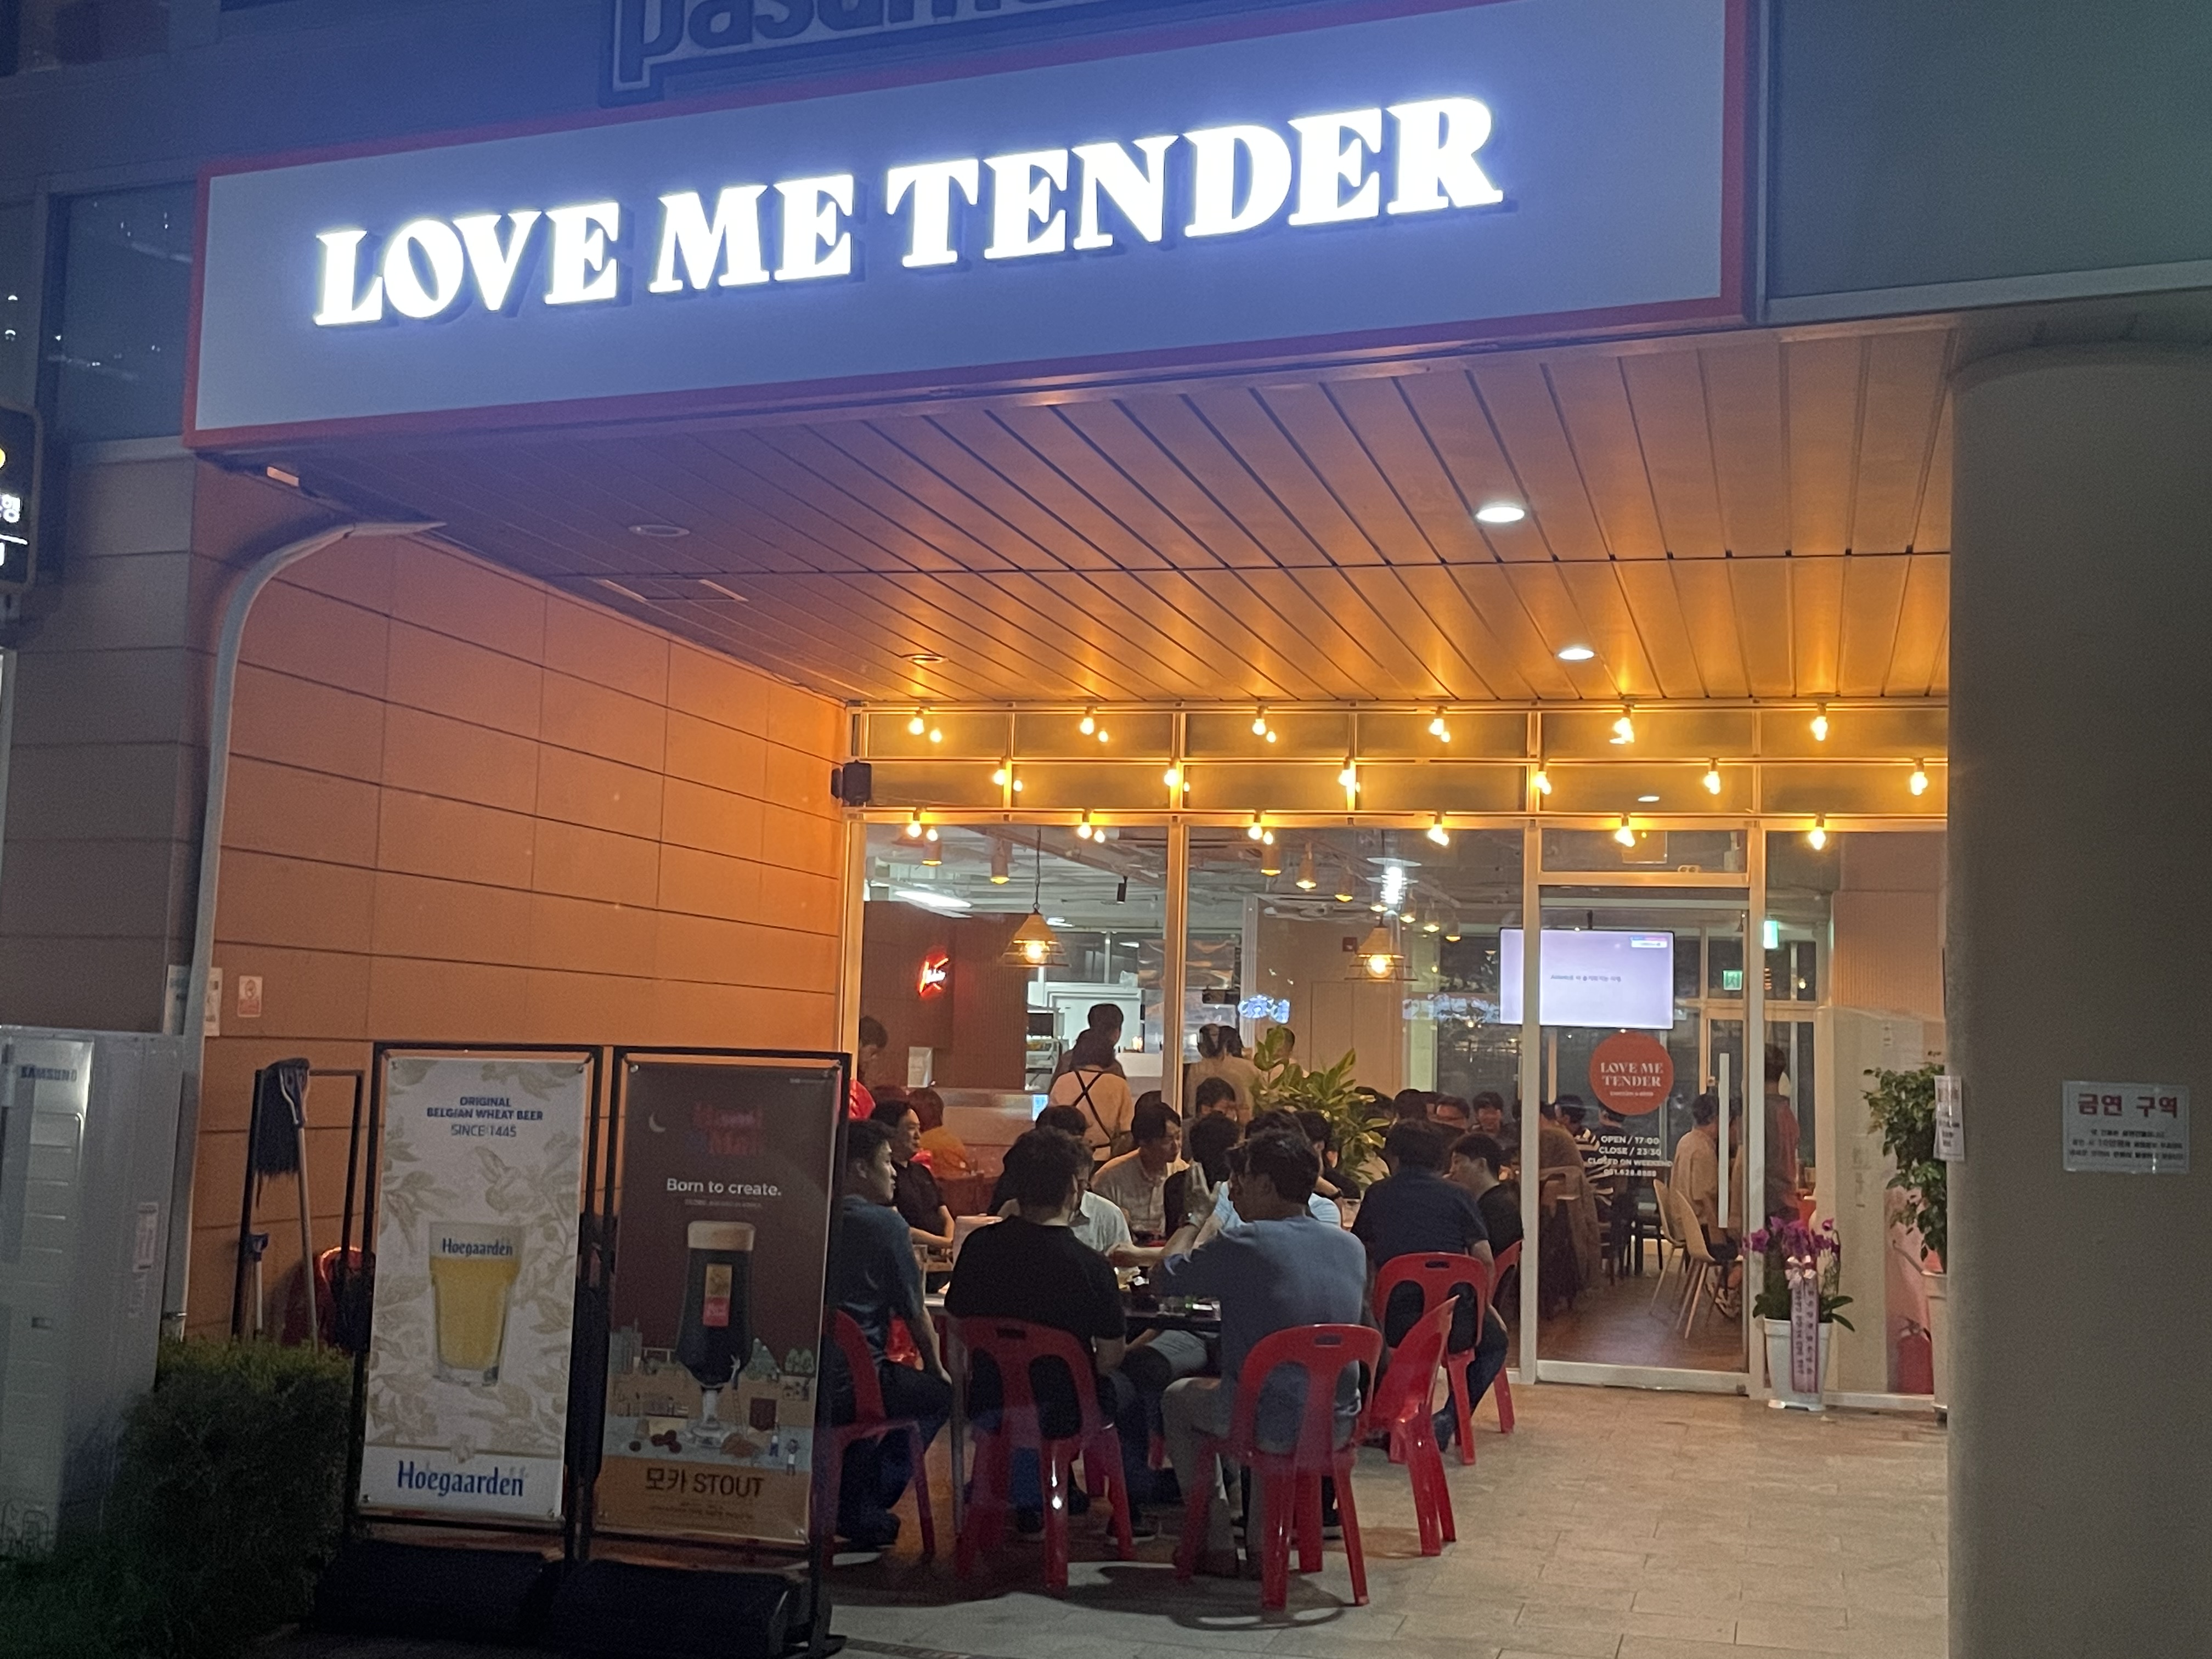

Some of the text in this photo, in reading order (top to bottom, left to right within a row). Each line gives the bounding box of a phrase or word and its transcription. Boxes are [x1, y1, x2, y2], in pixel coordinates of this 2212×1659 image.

[313, 97, 1503, 326] LOVE ME TENDER
[1600, 1062, 1664, 1075] LOVE ME
[1602, 1075, 1662, 1087] TENDER
[460, 1096, 511, 1107] ORIGINAL
[2078, 1093, 2178, 1119] 금연 구역
[426, 1107, 543, 1121] BELGIAN WHEAT BEER
[450, 1124, 517, 1138] SINCE 1445
[1600, 1135, 1627, 1143] OPEN
[1598, 1146, 1628, 1155] CLOSE
[666, 1178, 782, 1197] Born to create.
[442, 1238, 514, 1257] Hoegaarden
[398, 1460, 523, 1497] Hoegaarden
[645, 1467, 764, 1498] 모카 STOUT
